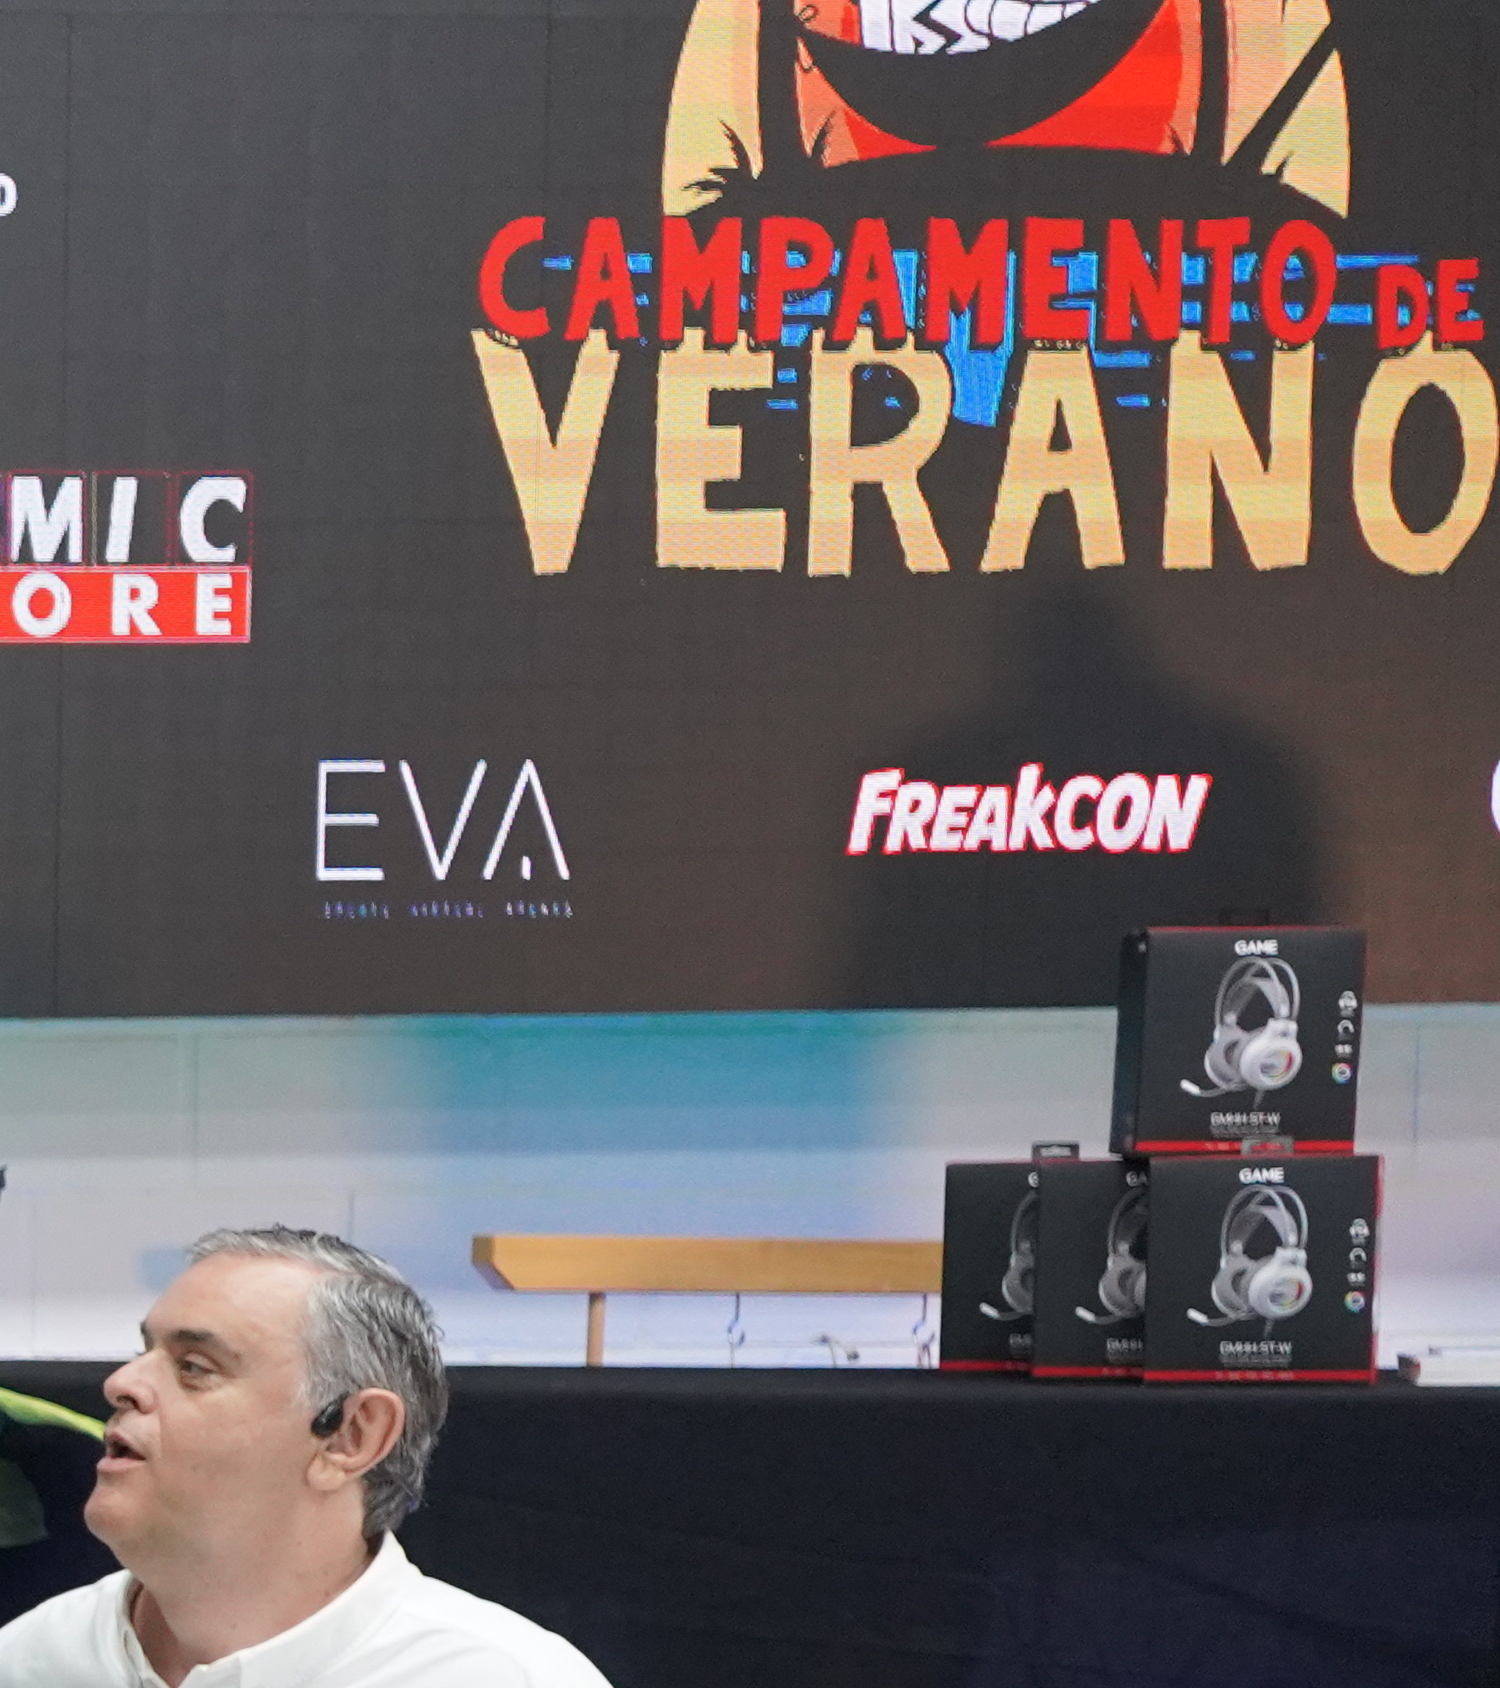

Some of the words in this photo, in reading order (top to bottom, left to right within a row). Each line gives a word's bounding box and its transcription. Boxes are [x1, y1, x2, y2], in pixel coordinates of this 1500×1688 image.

[479, 214, 1337, 343] CAMPAMENTO
[1378, 258, 1484, 348] DE
[471, 328, 1500, 577] VERANO
[316, 758, 571, 881] EVA
[1234, 939, 1279, 956] GAME
[1238, 1166, 1286, 1185] GAME
